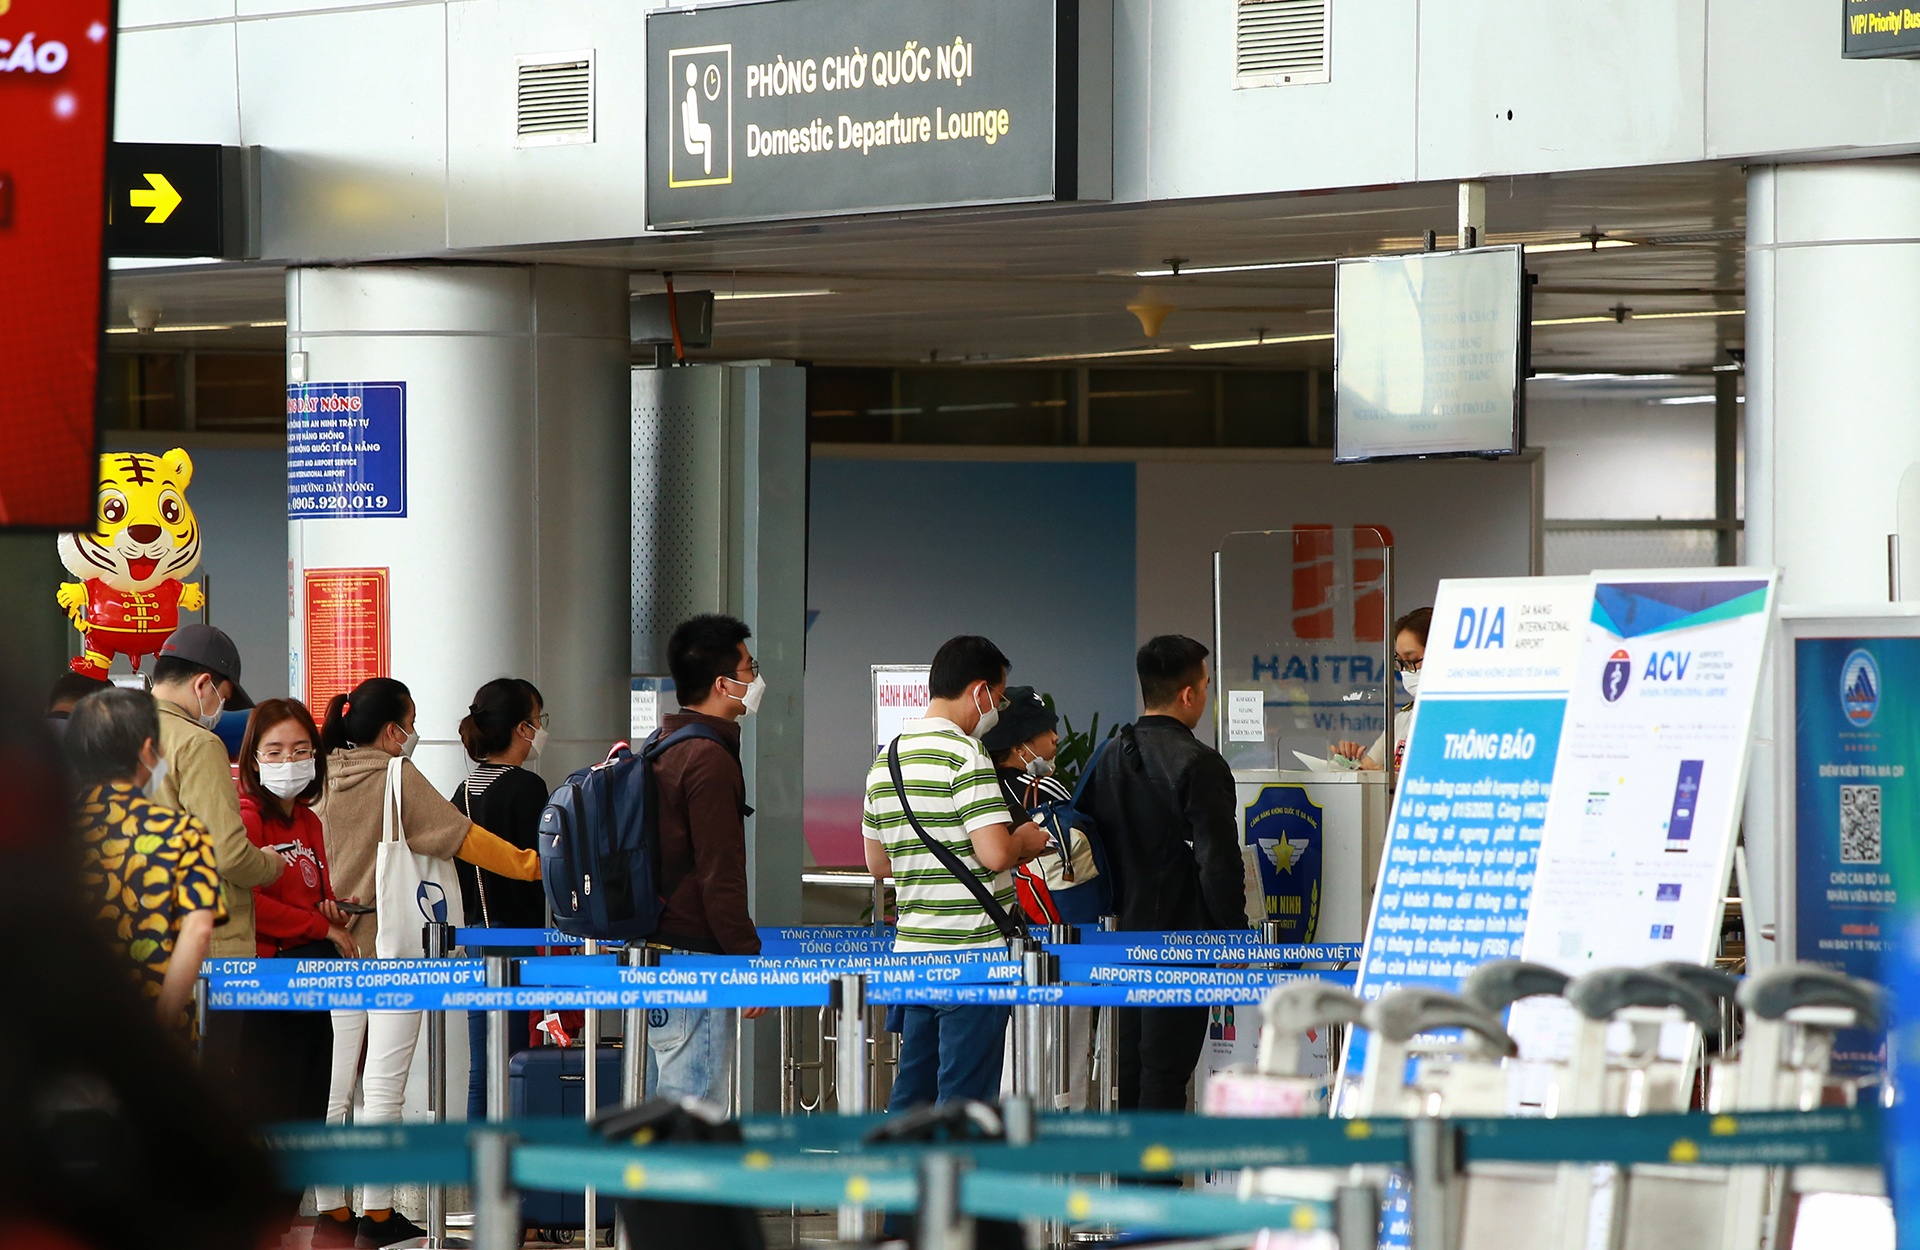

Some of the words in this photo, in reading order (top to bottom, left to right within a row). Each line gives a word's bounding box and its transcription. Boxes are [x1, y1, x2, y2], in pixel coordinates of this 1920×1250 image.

[1850, 13, 1868, 35] VIP/
[1868, 9, 1903, 36] Priority/
[747, 54, 817, 99] PHÒNG
[821, 46, 868, 92] CHỜ
[871, 40, 932, 88] QUỐC
[936, 36, 973, 87] NỘI
[747, 117, 834, 158] Domestic
[838, 111, 931, 156] Departure
[936, 106, 1009, 145] Lounge
[319, 392, 362, 412] NÓNG
[310, 419, 320, 428] AN
[338, 417, 357, 430] TRẬT
[358, 417, 370, 430] TỰ
[319, 430, 345, 440] KHÔNG
[354, 440, 381, 452] NẴNG
[334, 458, 357, 467] SERVICE
[323, 470, 346, 478] AIRPORT
[345, 481, 374, 492] NÓNG
[292, 495, 389, 510] 0905.920.019
[1452, 606, 1505, 650] DIA
[1643, 650, 1691, 682] ACV
[879, 679, 901, 707] HÀNH
[902, 679, 929, 707] KHÁCH
[1444, 728, 1499, 760] THÔNG
[1499, 728, 1536, 760] BÁO
[1266, 895, 1278, 914] AN
[1279, 895, 1301, 915] NINH
[544, 930, 577, 943] TỔNG
[1162, 932, 1193, 946] TỔNG
[1194, 933, 1227, 946] CÔNG
[1228, 933, 1244, 945] TY
[800, 938, 832, 954] TỔNG
[834, 938, 868, 953] CÔNG
[871, 939, 887, 952] TY
[1126, 945, 1159, 960] TỔNG
[1160, 945, 1194, 960] CÔNG
[1196, 947, 1211, 960] TY
[1212, 945, 1246, 960] CẢNG
[1248, 946, 1281, 960] HÀNG
[1283, 945, 1324, 960] KHÔNG
[1325, 944, 1353, 961] VIỆT
[223, 961, 257, 975] CTCP
[296, 960, 360, 975] AIRPORTS
[820, 957, 835, 969] TY
[838, 954, 872, 970] CẢNG
[874, 952, 907, 968] HÀNG
[910, 951, 952, 967] KHÔNG
[982, 950, 1009, 963] NAM
[355, 972, 452, 988] CORPORATION
[453, 971, 470, 985] OF
[618, 968, 656, 985] TỔNG
[658, 969, 698, 985] CÔNG
[700, 972, 717, 985] TY
[720, 968, 758, 985] CẢNG
[760, 969, 799, 984] HÀNG
[884, 970, 915, 983] NAM
[926, 968, 960, 983] CTCP
[1089, 967, 1152, 984] AIRPORTS
[1154, 969, 1244, 985] CORPORATION
[1246, 971, 1264, 985] OF
[236, 990, 290, 1007] KHÔNG
[327, 992, 363, 1006] NAM
[375, 991, 414, 1008] CTCP
[442, 991, 514, 1007] AIRPORTS
[516, 990, 625, 1007] CORPORATION
[626, 990, 641, 1006] OF
[641, 989, 709, 1006] VIETNAM
[987, 987, 1019, 1002] NAM
[1027, 987, 1064, 1003] CTCP
[1125, 989, 1193, 1005] AIRPORTS
